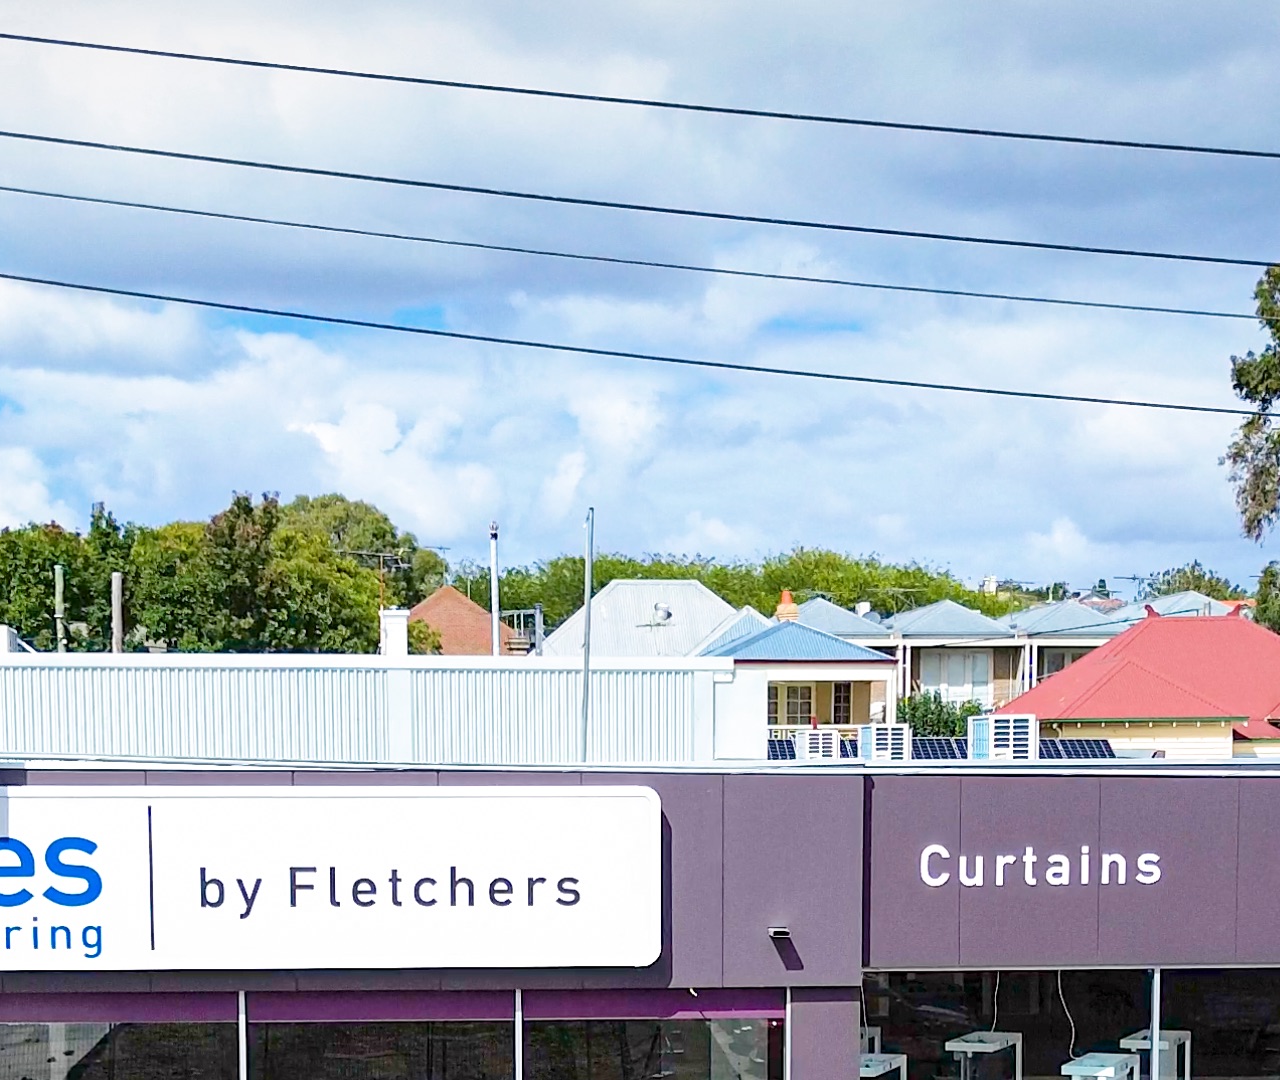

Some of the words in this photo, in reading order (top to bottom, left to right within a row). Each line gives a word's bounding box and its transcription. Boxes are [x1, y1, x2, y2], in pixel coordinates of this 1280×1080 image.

[919, 843, 1163, 887] Curtains
[199, 867, 262, 920] by
[289, 866, 582, 908] Fletchers
